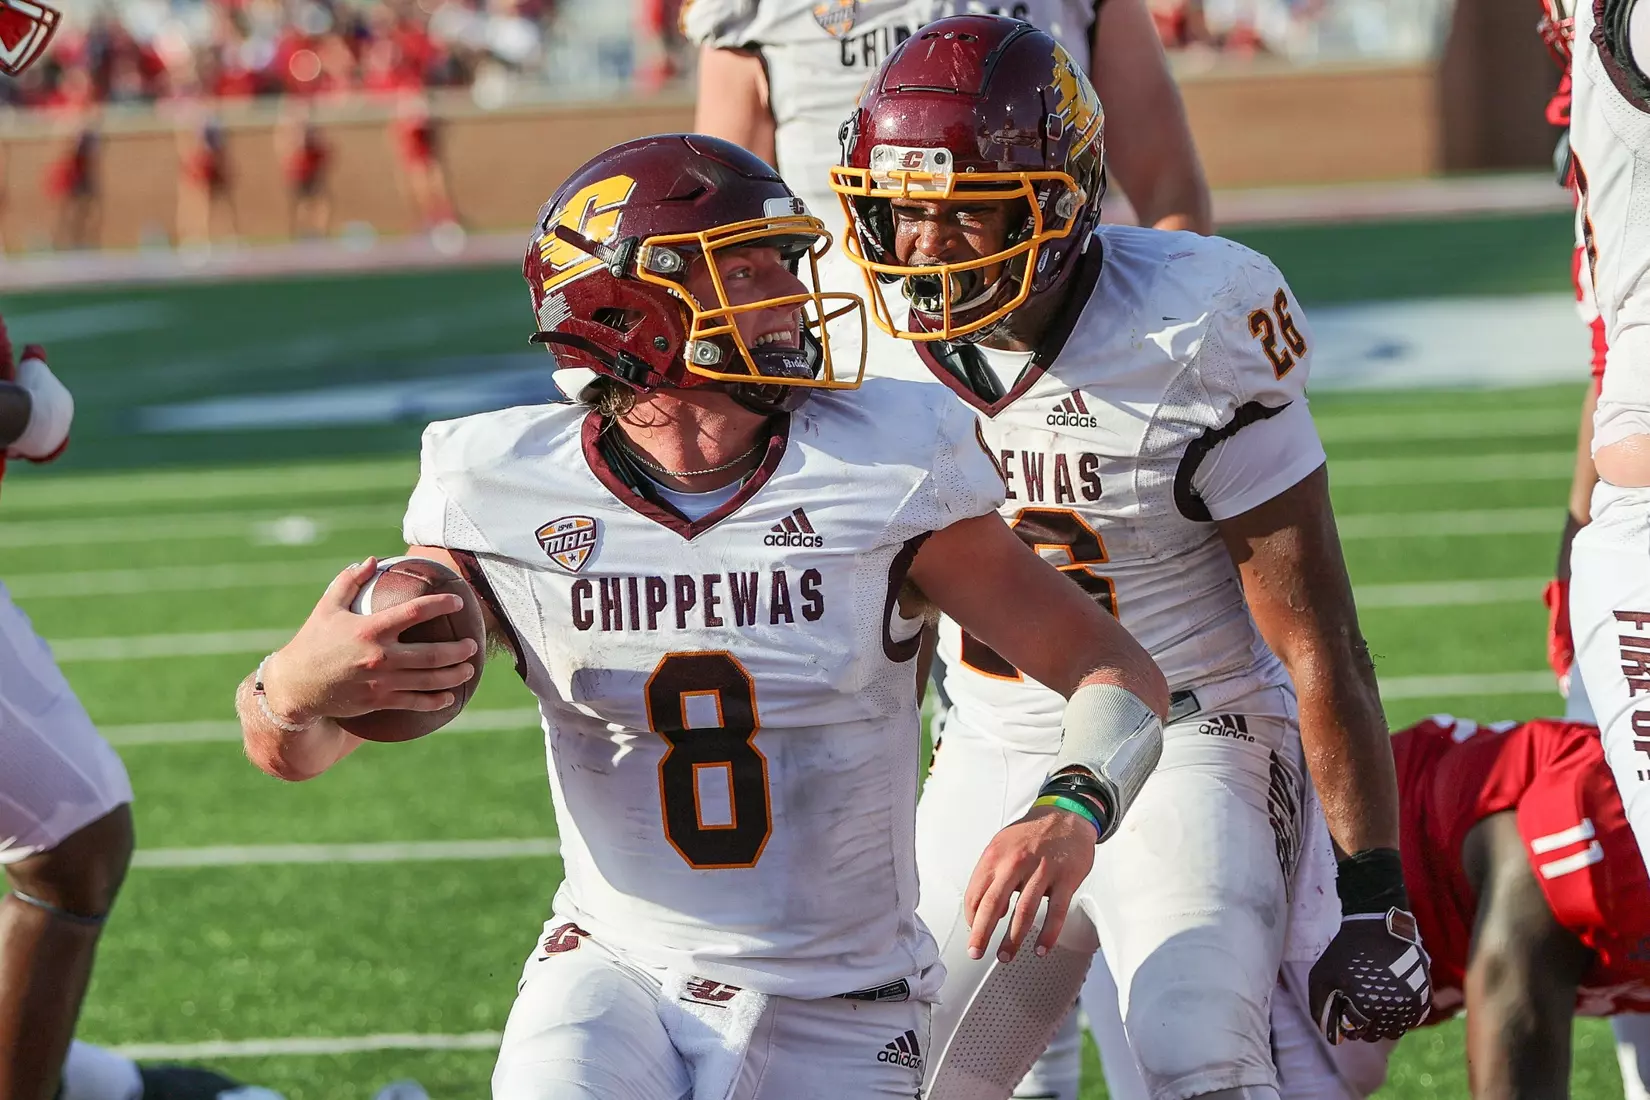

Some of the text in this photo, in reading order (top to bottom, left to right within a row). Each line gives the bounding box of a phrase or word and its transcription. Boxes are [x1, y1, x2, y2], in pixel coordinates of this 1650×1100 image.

[1247, 287, 1309, 381] 26
[1046, 411, 1098, 429] adidas
[763, 531, 824, 549] adidas
[571, 567, 825, 632] CHIPPEWAS
[1198, 723, 1256, 743] adidas
[644, 650, 773, 870] 8
[876, 1050, 923, 1069] adidas
